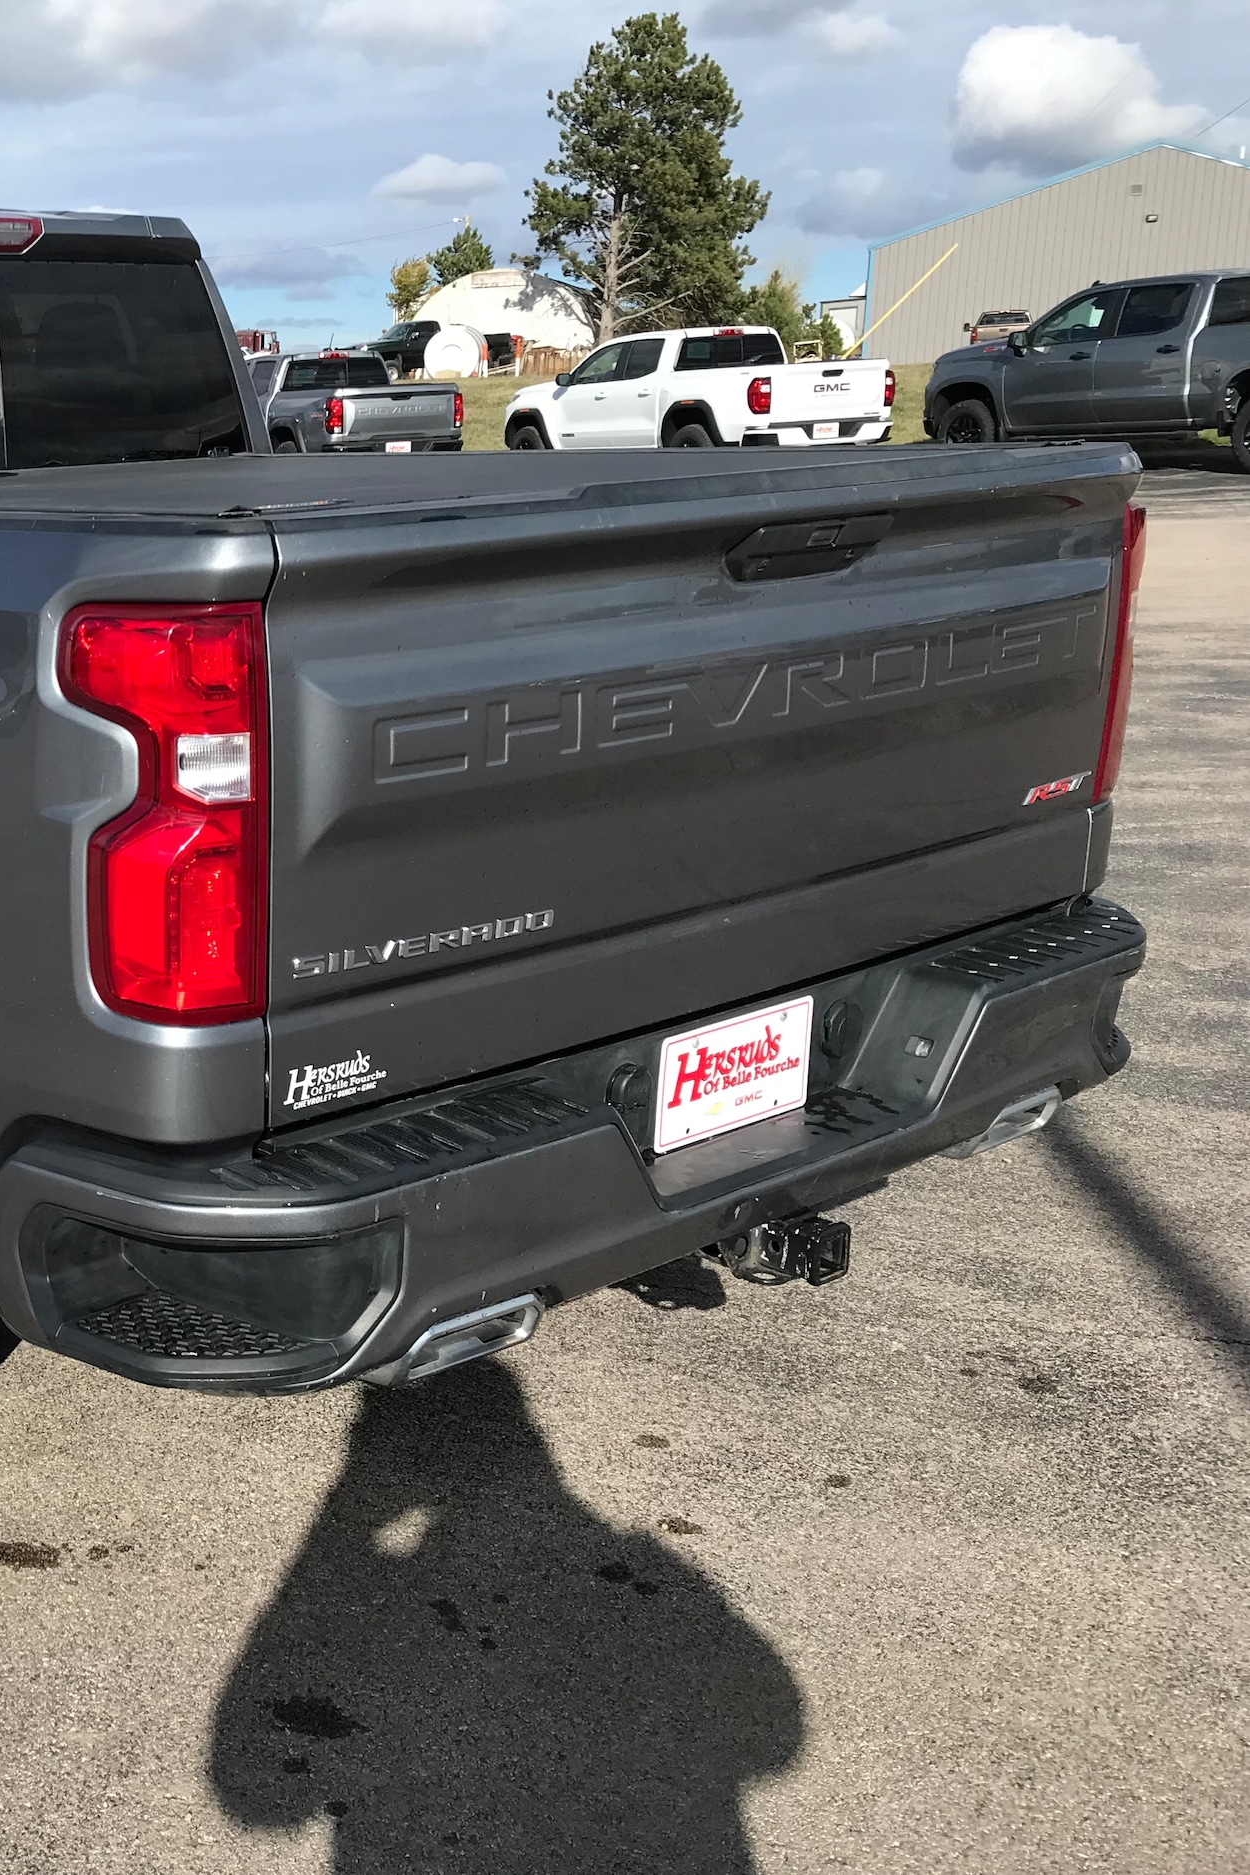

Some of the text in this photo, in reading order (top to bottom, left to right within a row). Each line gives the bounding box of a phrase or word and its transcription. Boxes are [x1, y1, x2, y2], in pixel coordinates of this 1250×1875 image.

[813, 383, 851, 393] GMC
[372, 604, 1098, 784] CHEVROLET
[1021, 770, 1093, 806] RST
[292, 908, 555, 980] SILVERADO
[310, 1069, 387, 1097] Of Belle Fourche
[703, 1055, 800, 1095] Of Belle Fourche
[293, 1081, 378, 1110] CHEVROLET BUICK GMC
[734, 1090, 763, 1106] GMC
